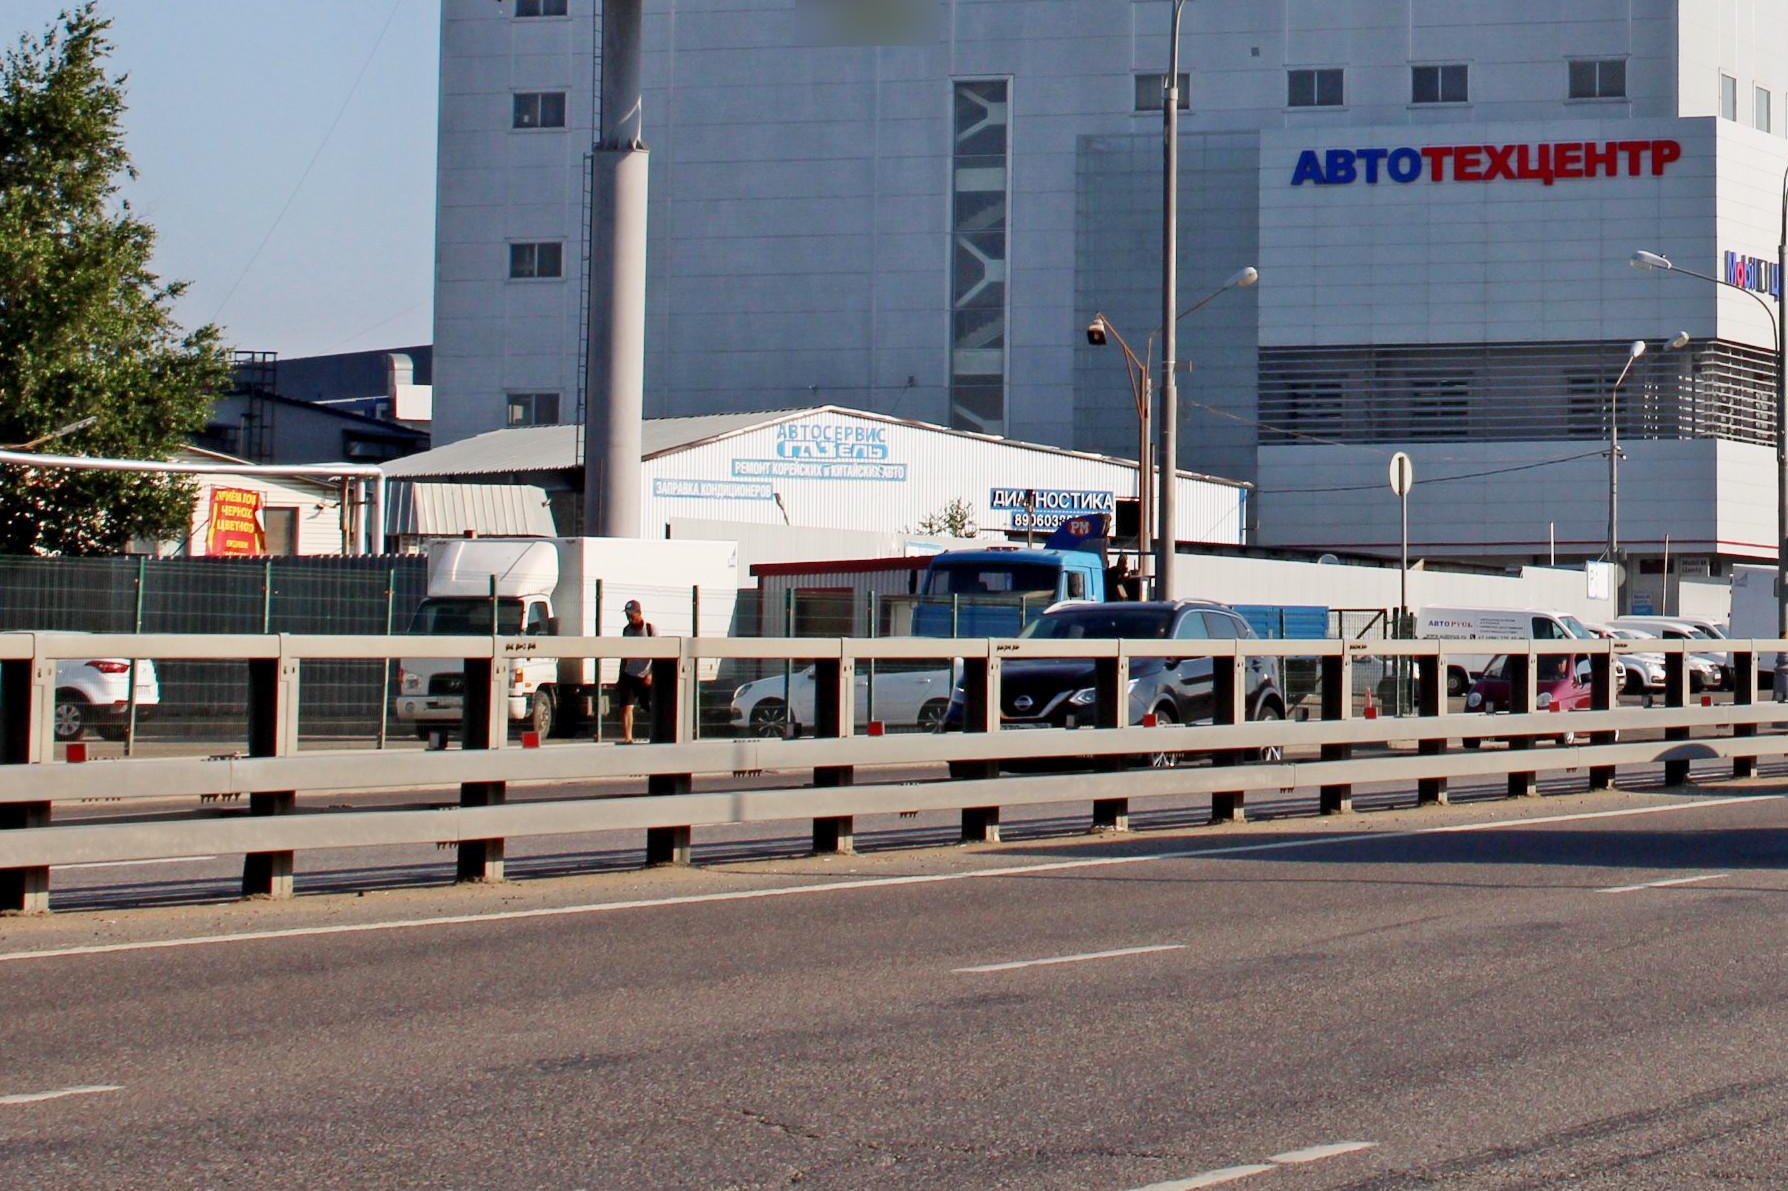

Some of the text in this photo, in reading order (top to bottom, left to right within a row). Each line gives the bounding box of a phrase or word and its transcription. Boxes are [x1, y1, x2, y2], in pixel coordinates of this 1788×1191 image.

[1290, 140, 1680, 186] АВТОТЕХЦЕНТР
[777, 424, 886, 442] АВТОСЕРВИС
[784, 440, 883, 459] ГАЗЕЛЬ
[735, 461, 769, 476] РЕМОНТ
[771, 461, 822, 477] КОРЕЙСКИХ
[655, 481, 771, 498] ЗАПРАВКА КОНДИЦИОНЕРОВ
[993, 490, 1113, 510] ДИАНОСТИКА
